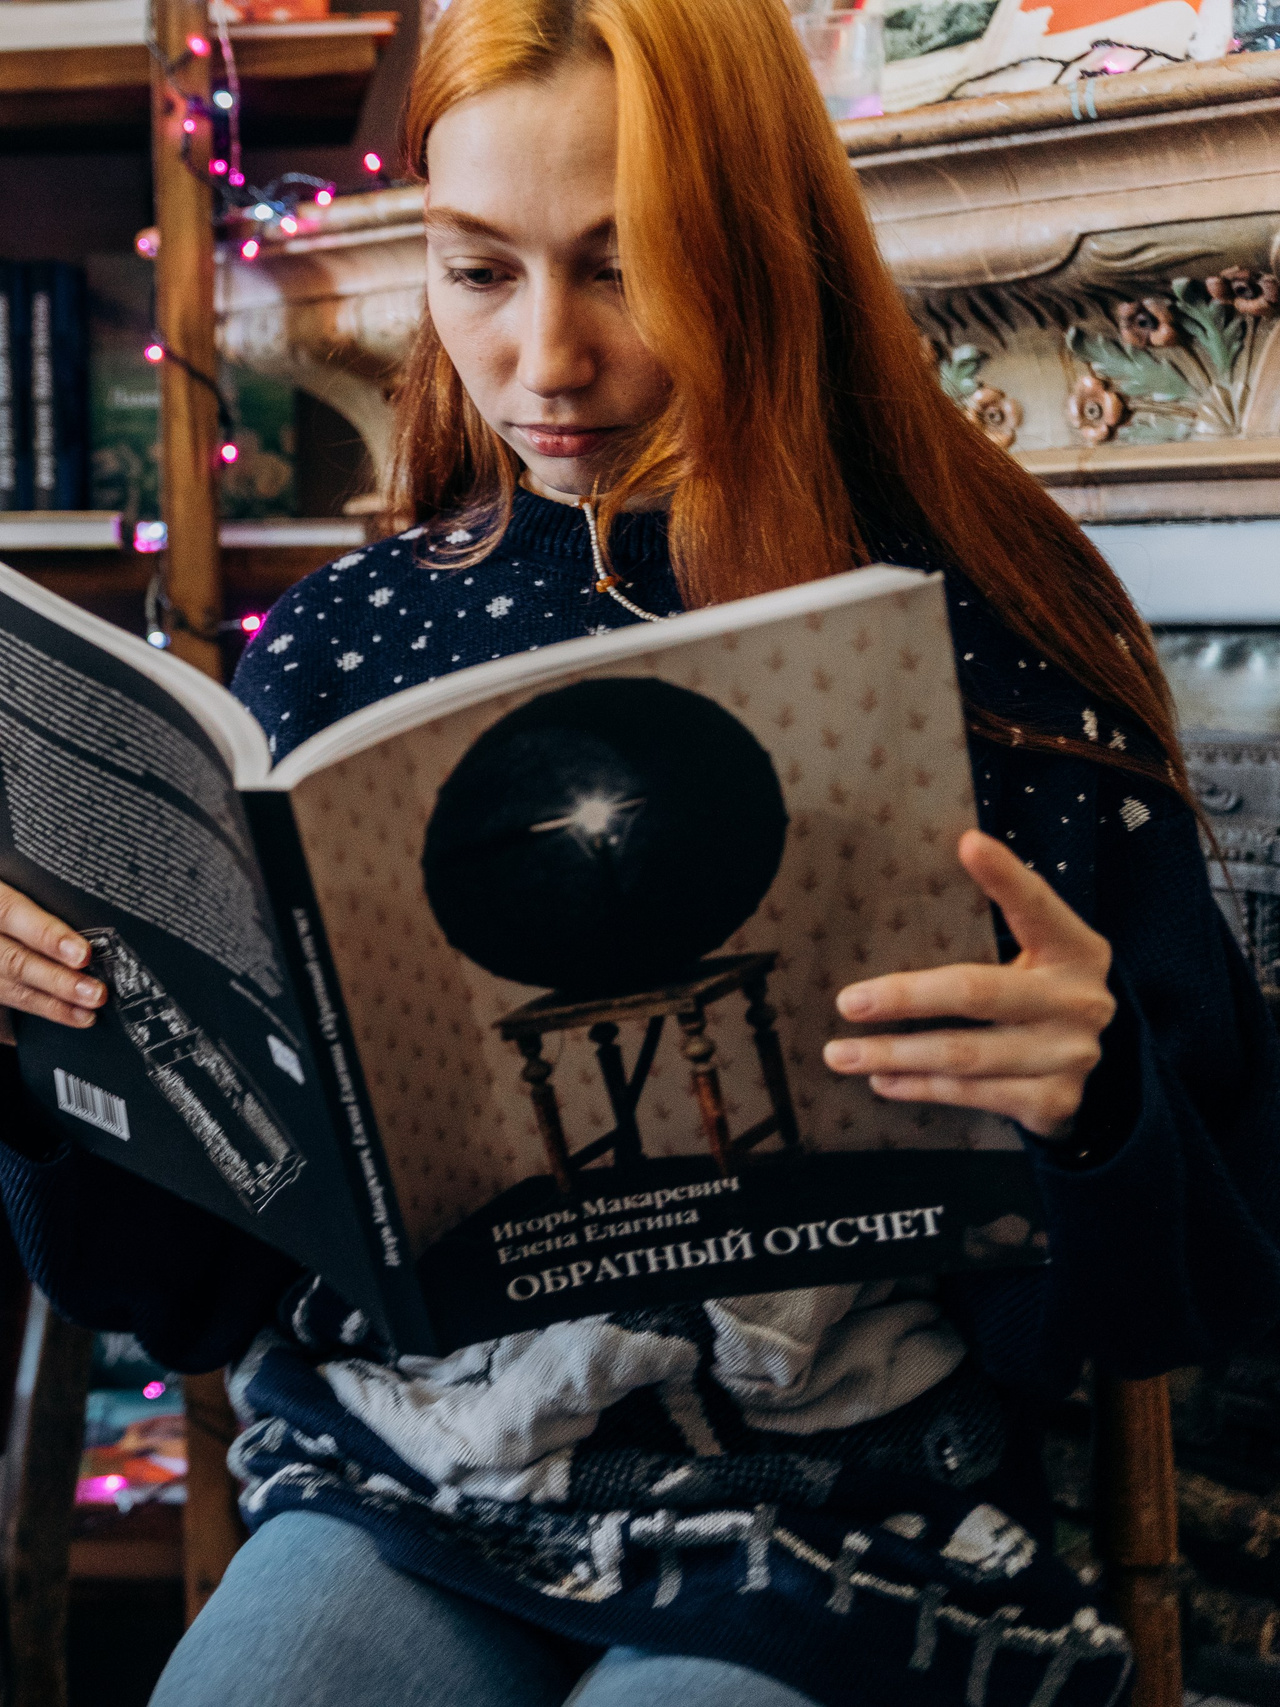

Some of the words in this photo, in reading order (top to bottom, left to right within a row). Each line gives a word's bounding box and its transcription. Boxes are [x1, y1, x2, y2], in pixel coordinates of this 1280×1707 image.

[491, 1208, 578, 1243] Игорь
[580, 1176, 740, 1219] Макаревич
[496, 1232, 579, 1265] Елена
[582, 1208, 700, 1243] Елагина
[506, 1227, 757, 1301] ОБРАТНЫЙ
[763, 1205, 945, 1255] ОТСЧЕТ
